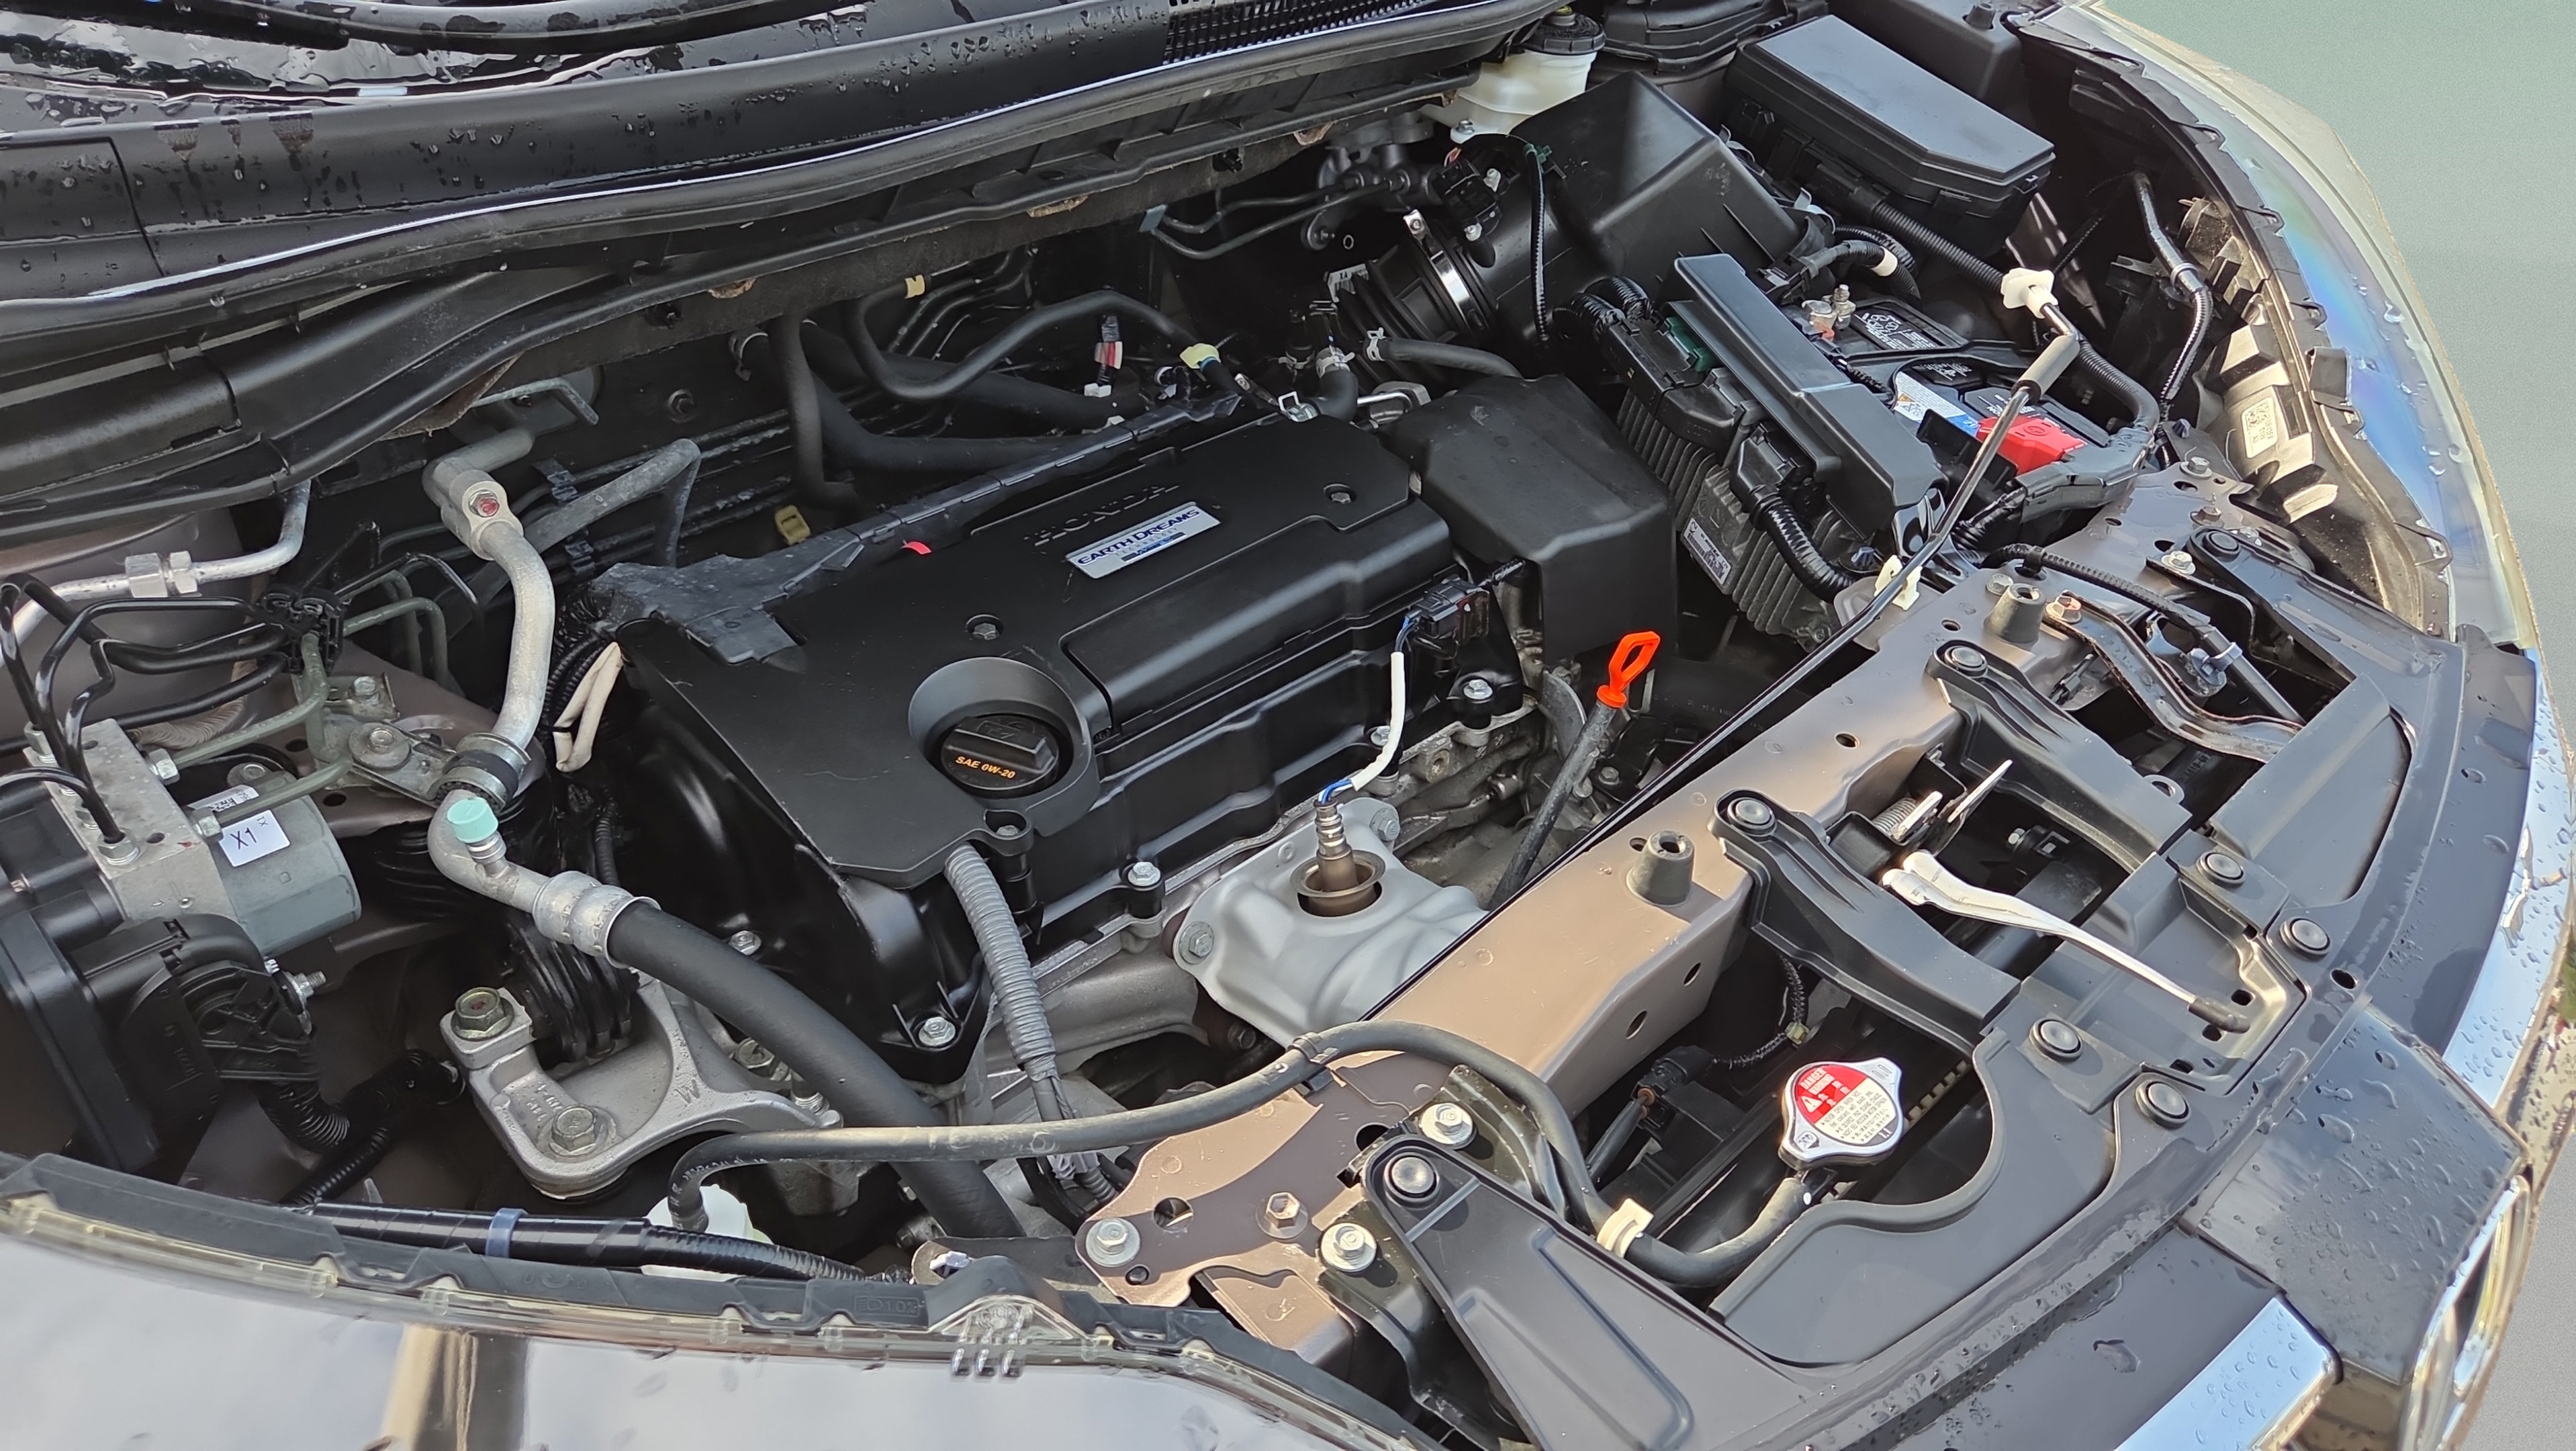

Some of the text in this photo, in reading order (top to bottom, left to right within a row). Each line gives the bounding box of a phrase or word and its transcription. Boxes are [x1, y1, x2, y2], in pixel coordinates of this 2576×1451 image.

[1022, 487, 1181, 547] HONDA
[1689, 521, 1698, 535] K2
[1077, 539, 1133, 564] EARTH
[1132, 509, 1199, 540] DREAMS
[1114, 527, 1179, 557] TECHNOLOGY
[955, 756, 1015, 779] SAE 0W-20
[230, 827, 257, 850] X1
[1800, 1067, 1827, 1090] DANGER
[1808, 1072, 1835, 1095] WARNING
